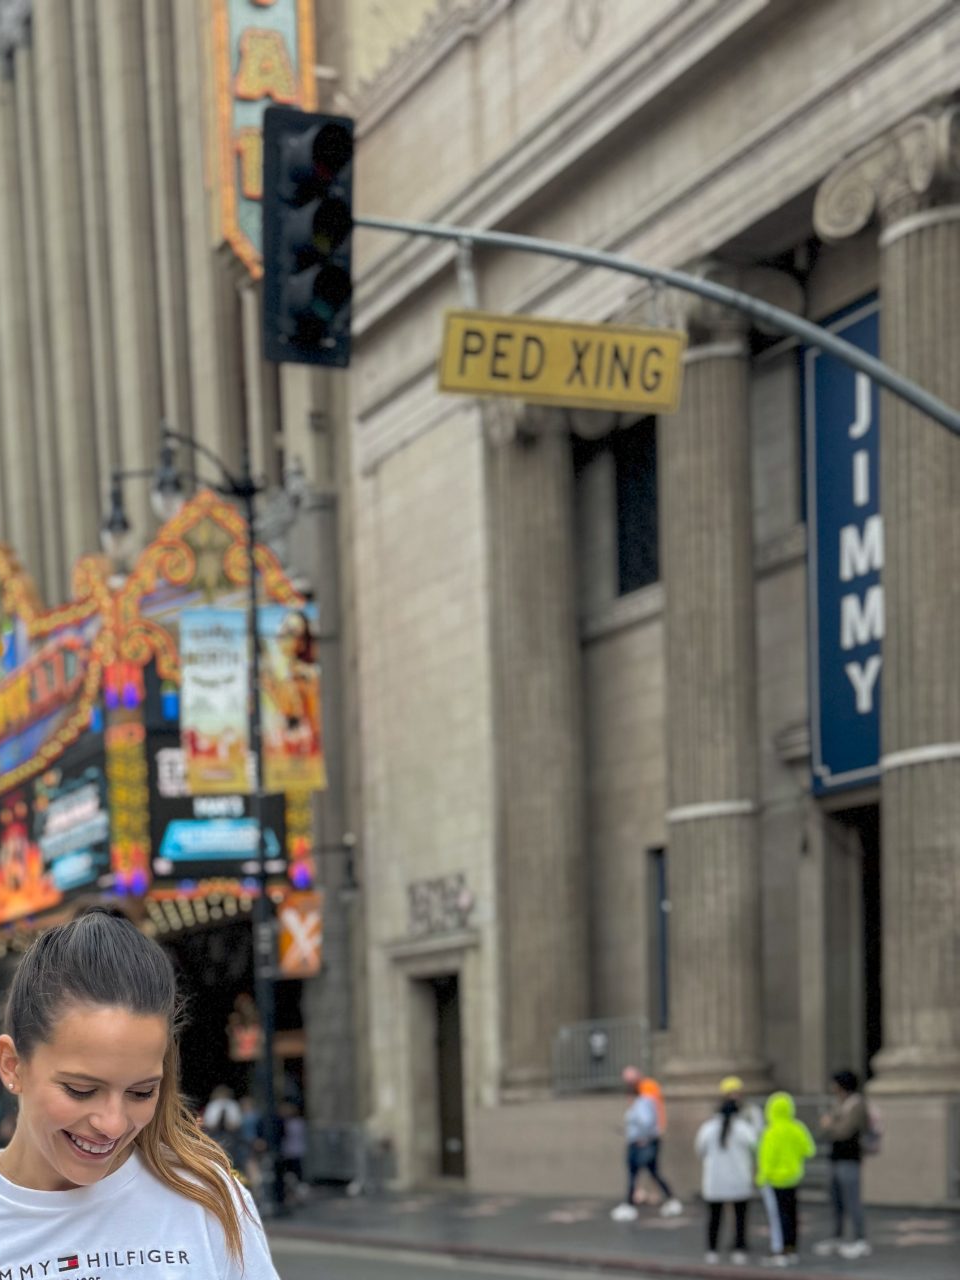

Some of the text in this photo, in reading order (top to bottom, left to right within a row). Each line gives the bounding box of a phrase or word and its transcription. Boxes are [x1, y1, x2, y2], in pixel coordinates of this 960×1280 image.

[458, 329, 664, 393] PED XING
[839, 368, 885, 714] JIMMY
[87, 1249, 190, 1268] HILFIGER
